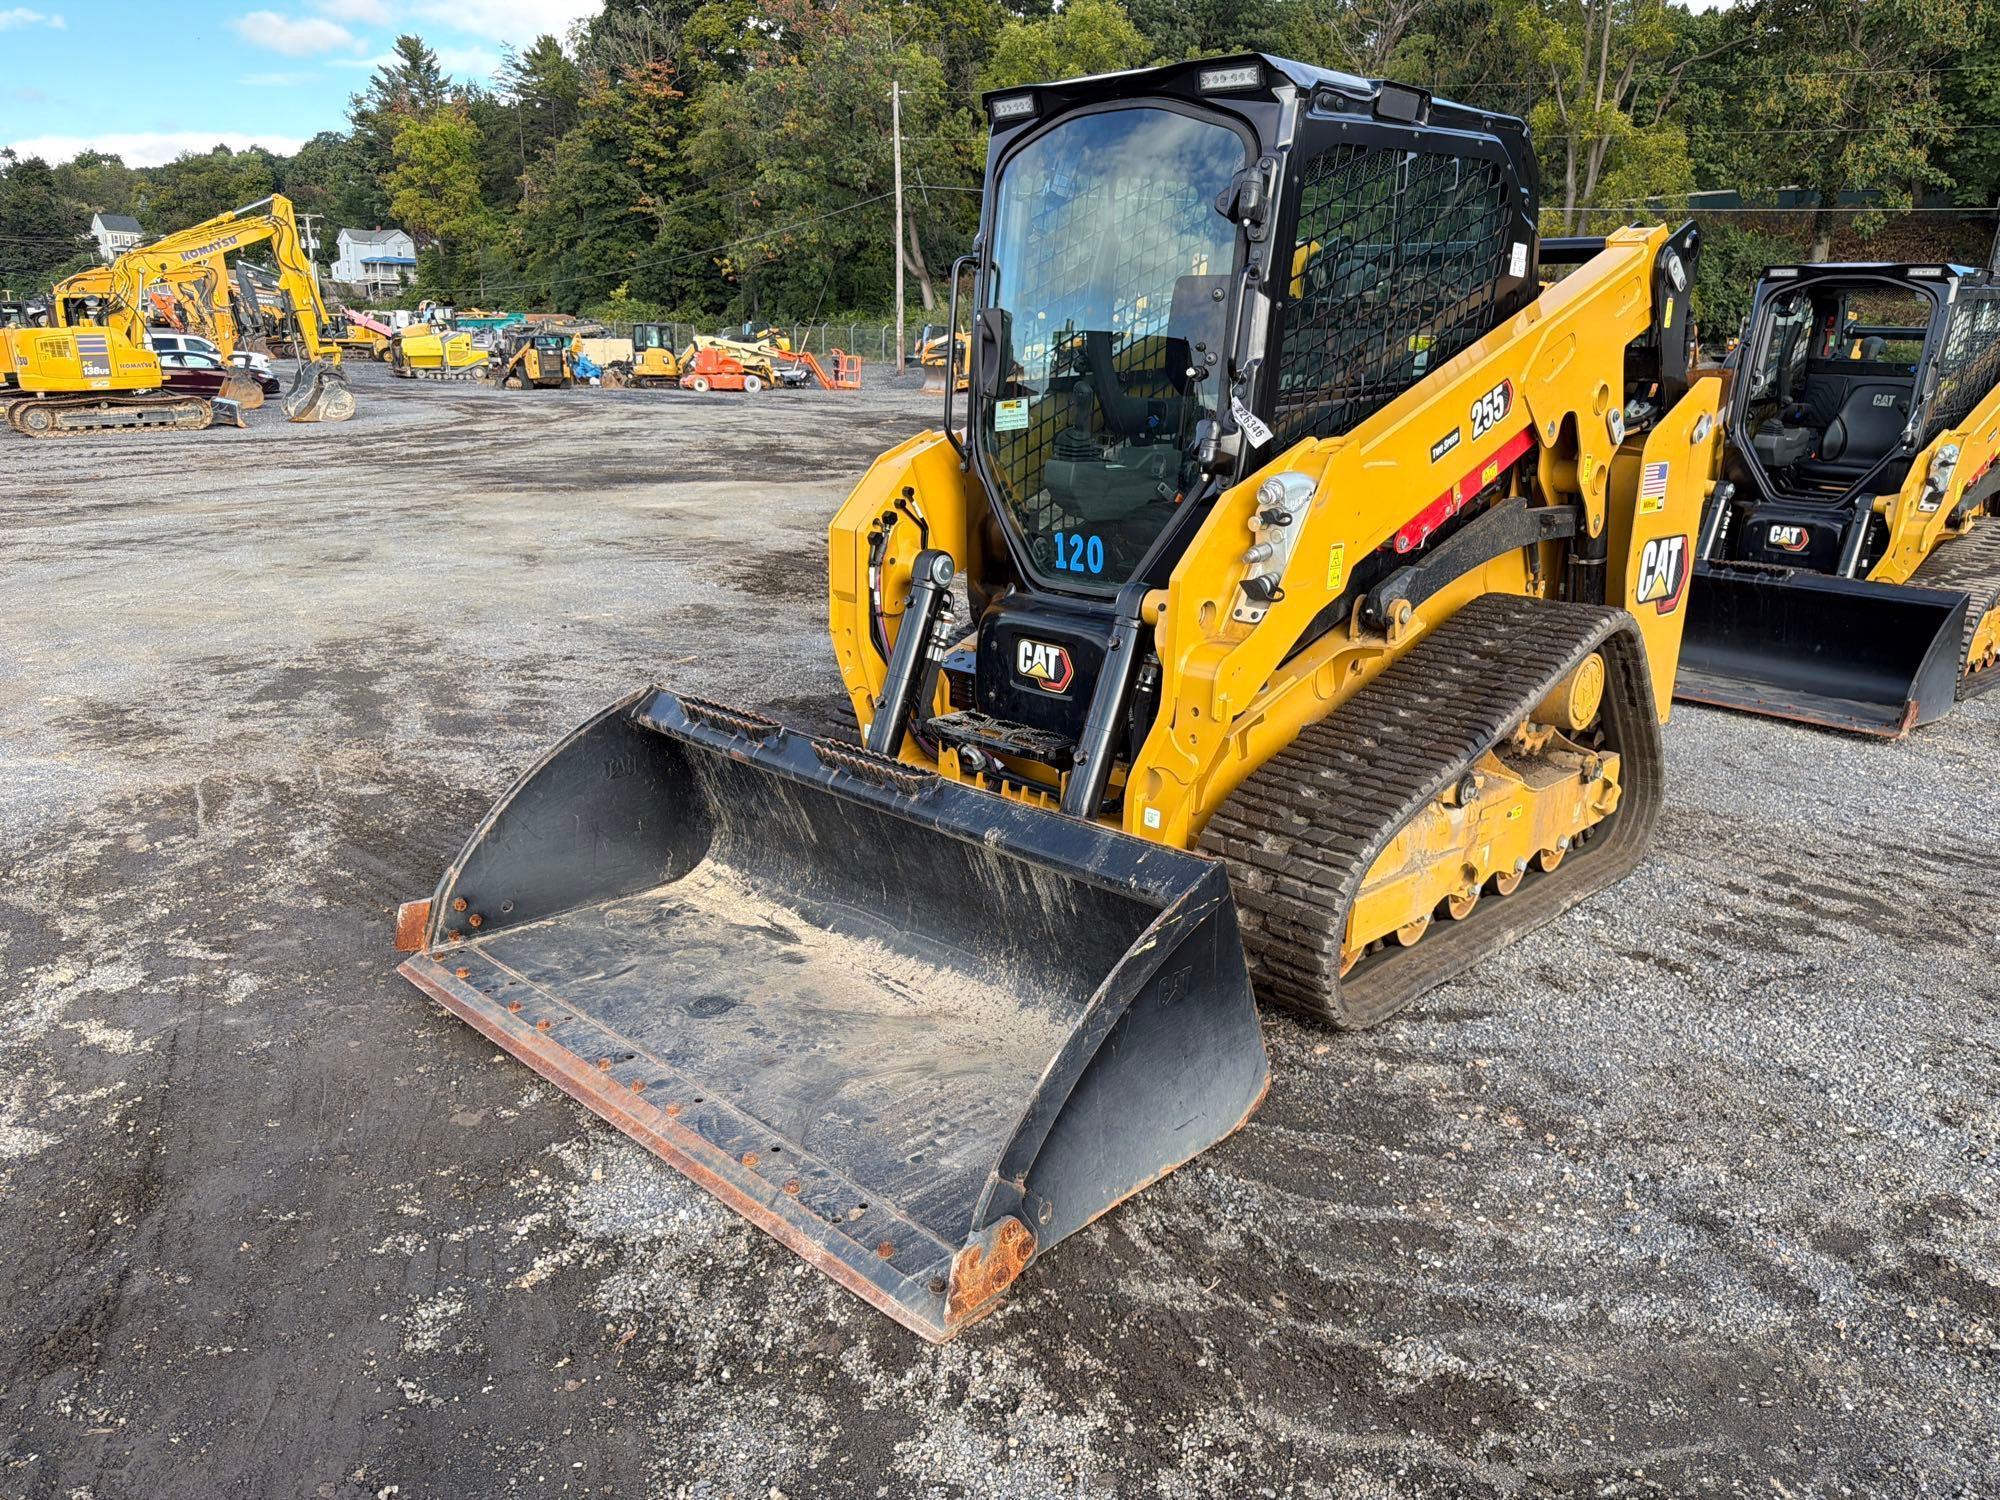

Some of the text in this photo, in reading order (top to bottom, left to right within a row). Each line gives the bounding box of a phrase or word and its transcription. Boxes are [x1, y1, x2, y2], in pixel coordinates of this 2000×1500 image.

[180, 235, 238, 261] KOMATSU
[119, 361, 152, 369] KOMATSU
[1470, 383, 1505, 440] 255
[1872, 393, 1897, 408] CAT
[1235, 407, 1265, 438] 226346
[1769, 525, 1801, 545] CAT
[1054, 532, 1104, 574] 120
[1637, 536, 1684, 603] CAT
[1018, 640, 1061, 680] CAT
